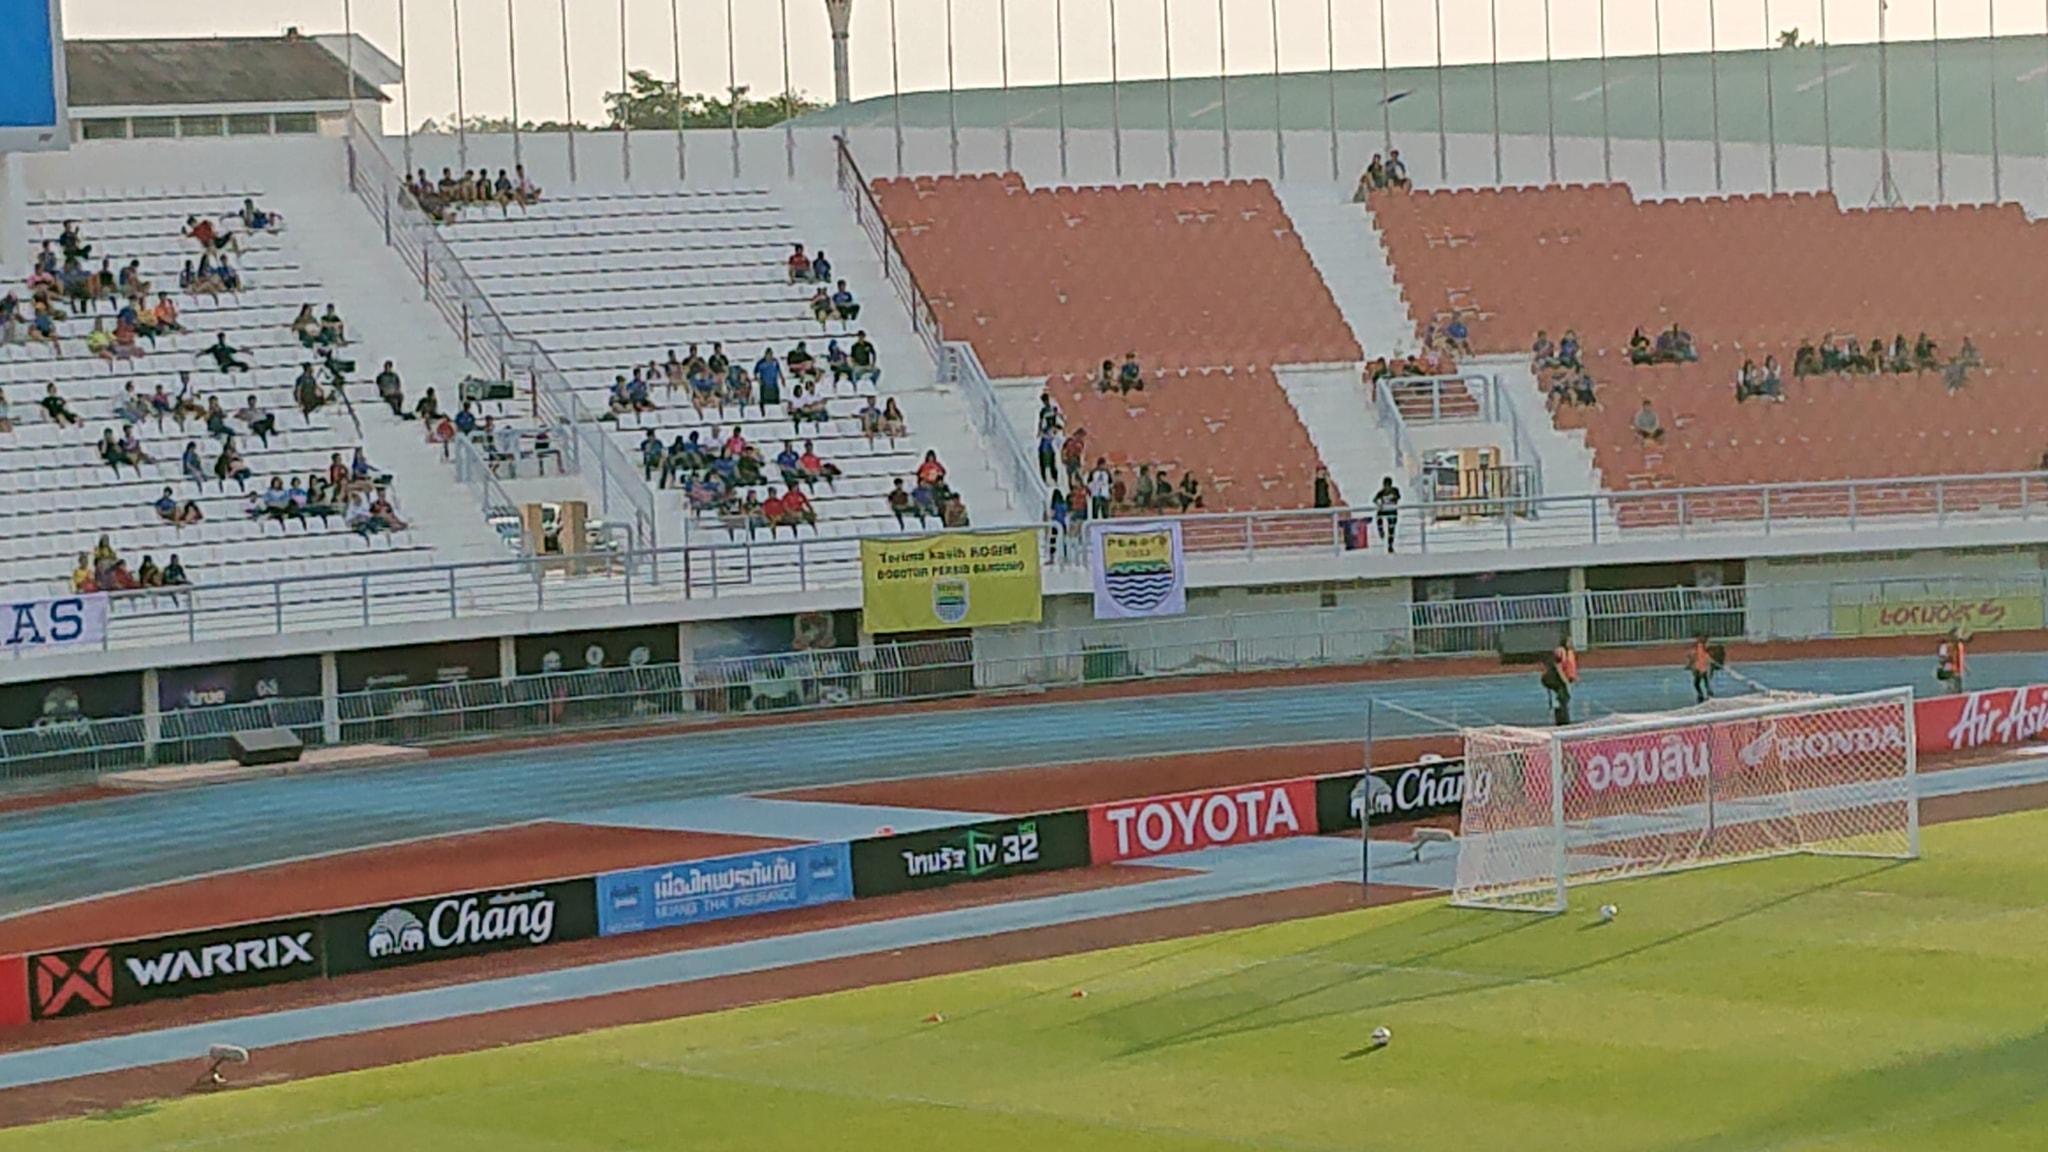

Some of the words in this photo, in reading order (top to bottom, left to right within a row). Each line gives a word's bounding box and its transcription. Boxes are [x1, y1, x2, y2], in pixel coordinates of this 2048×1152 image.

[0, 599, 83, 644] AS
[1107, 787, 1299, 855] TOYOTA
[975, 843, 996, 865] TV
[1002, 832, 1039, 864] 32
[428, 898, 555, 947] Chang
[126, 932, 314, 986] WARRIX
